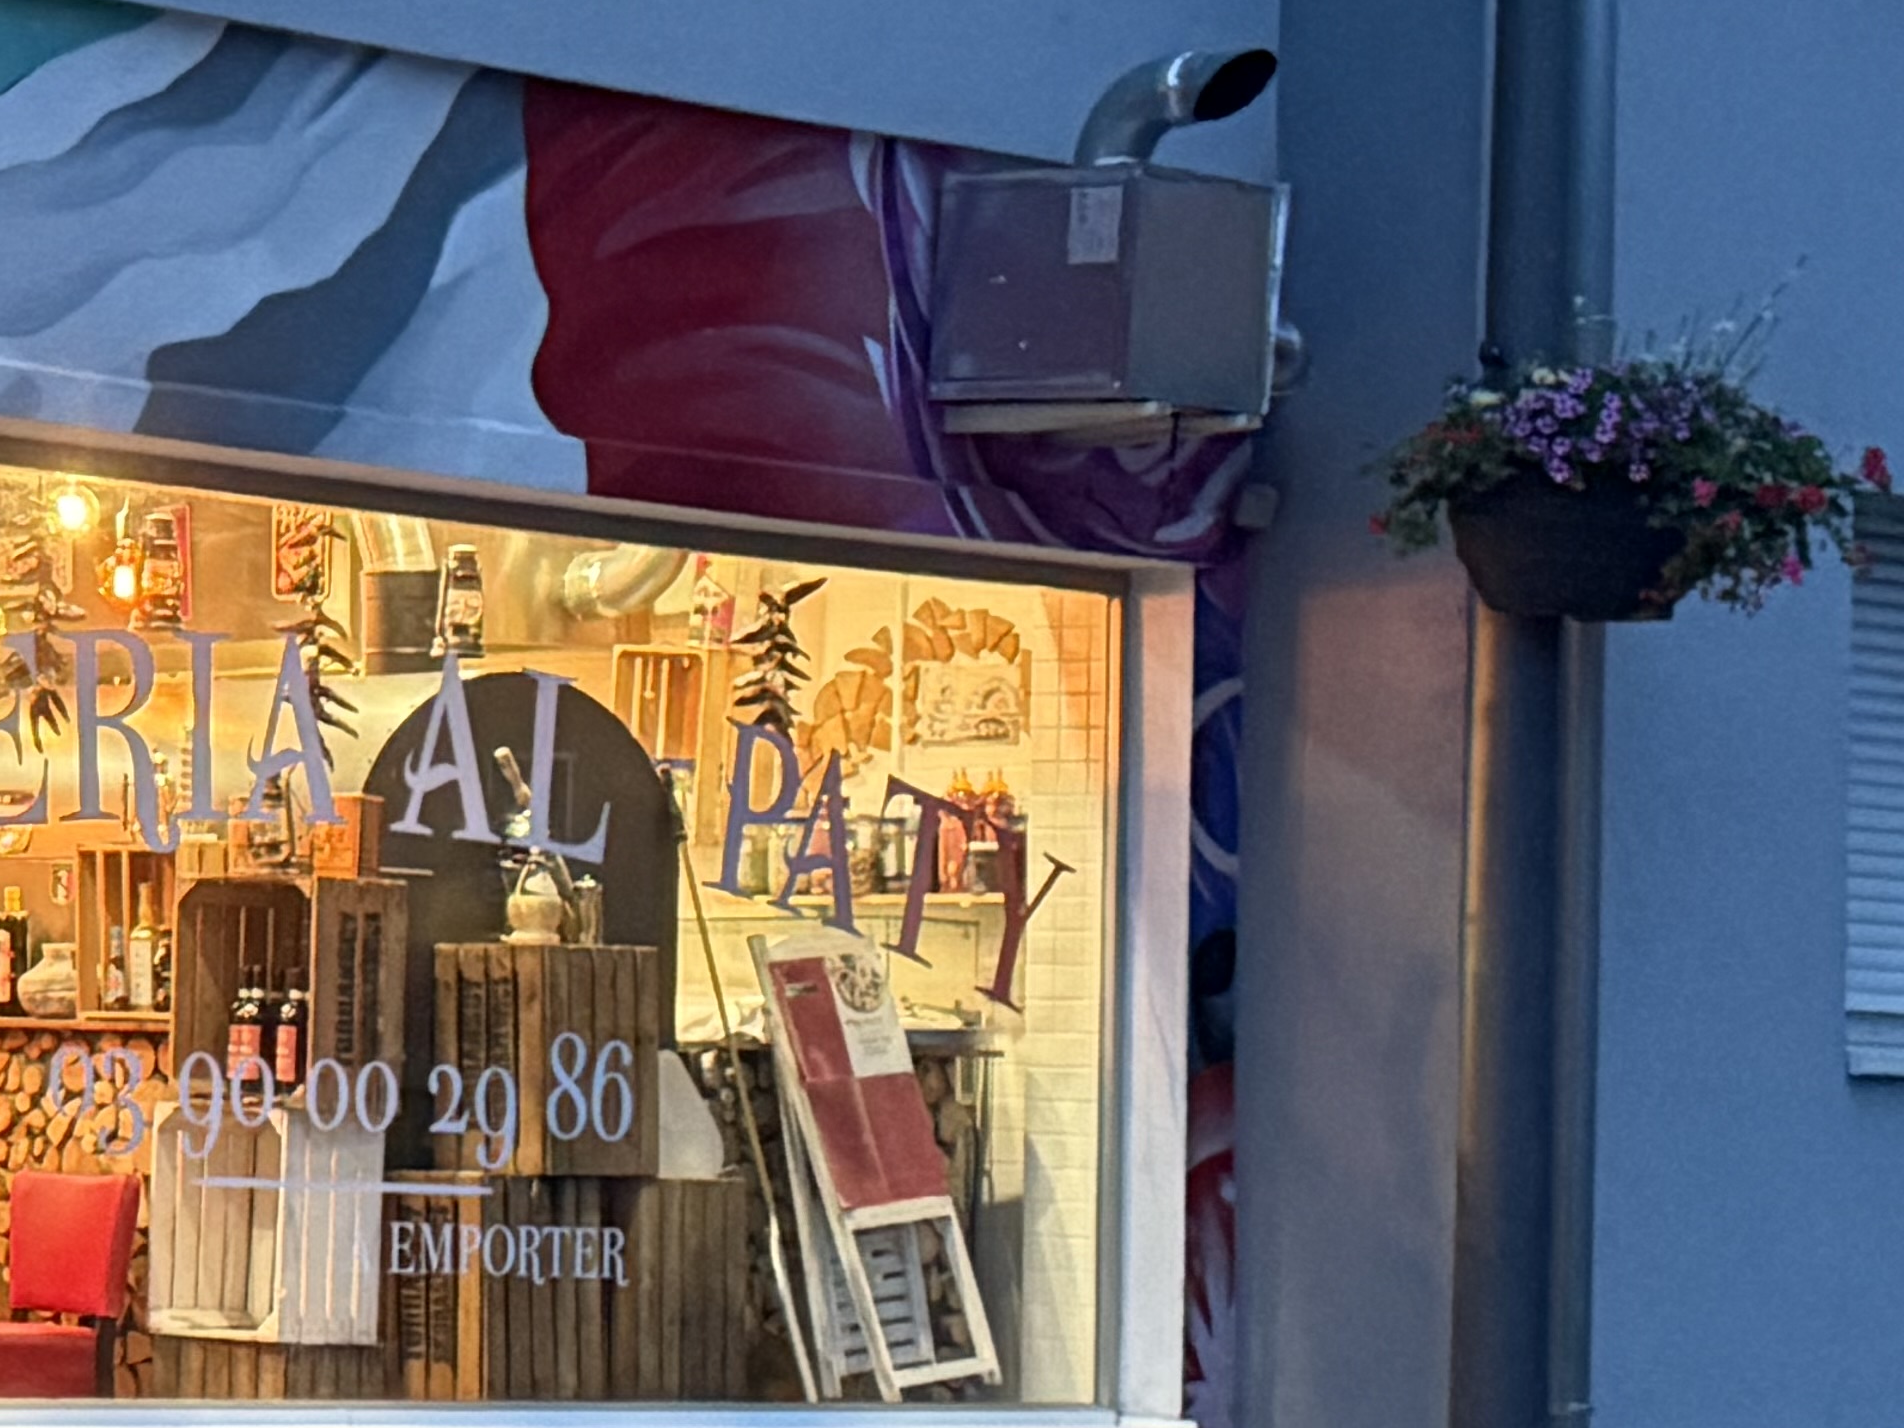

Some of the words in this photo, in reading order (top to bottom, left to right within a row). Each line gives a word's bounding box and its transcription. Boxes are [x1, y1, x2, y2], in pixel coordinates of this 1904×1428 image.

[389, 653, 609, 864] AL
[701, 716, 1078, 1014] PATY
[48, 1045, 145, 1156] 03
[176, 1050, 275, 1159] 90
[305, 1057, 399, 1133] 00
[428, 1063, 518, 1169] 29
[546, 1031, 634, 1142] 86
[389, 1221, 630, 1287] EMPORTER
